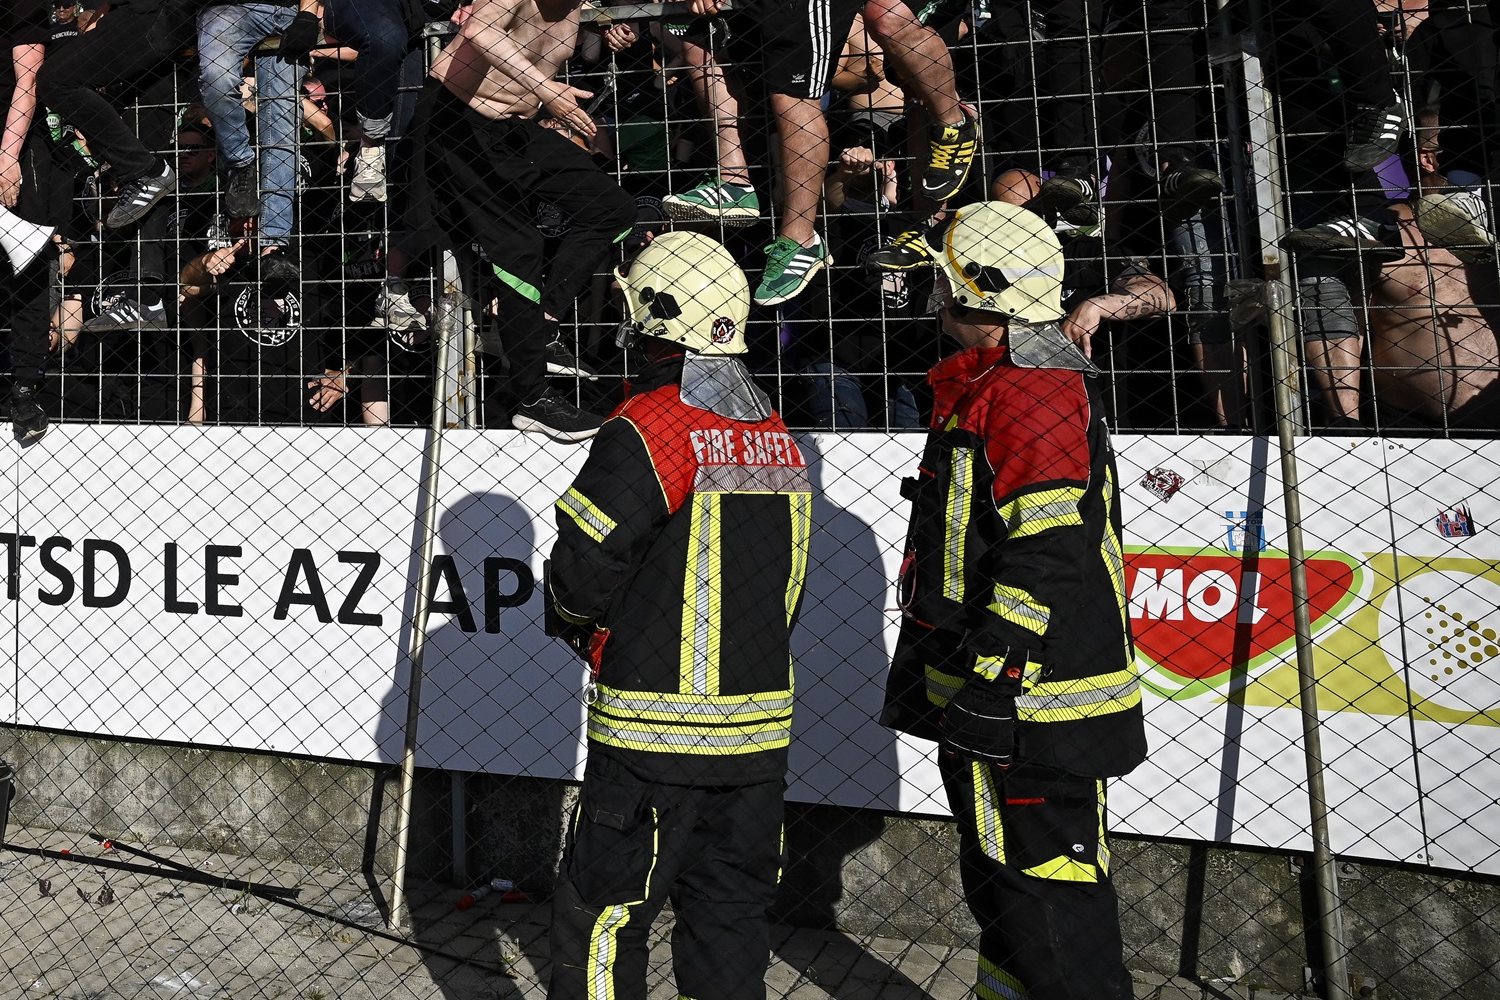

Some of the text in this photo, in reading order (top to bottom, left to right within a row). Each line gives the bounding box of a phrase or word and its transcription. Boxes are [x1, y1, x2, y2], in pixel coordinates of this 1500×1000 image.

[689, 429, 738, 465] FIRE
[164, 541, 244, 617] LE
[273, 548, 384, 627] AZ
[412, 554, 556, 637] AP
[1128, 567, 1269, 625] MOL
